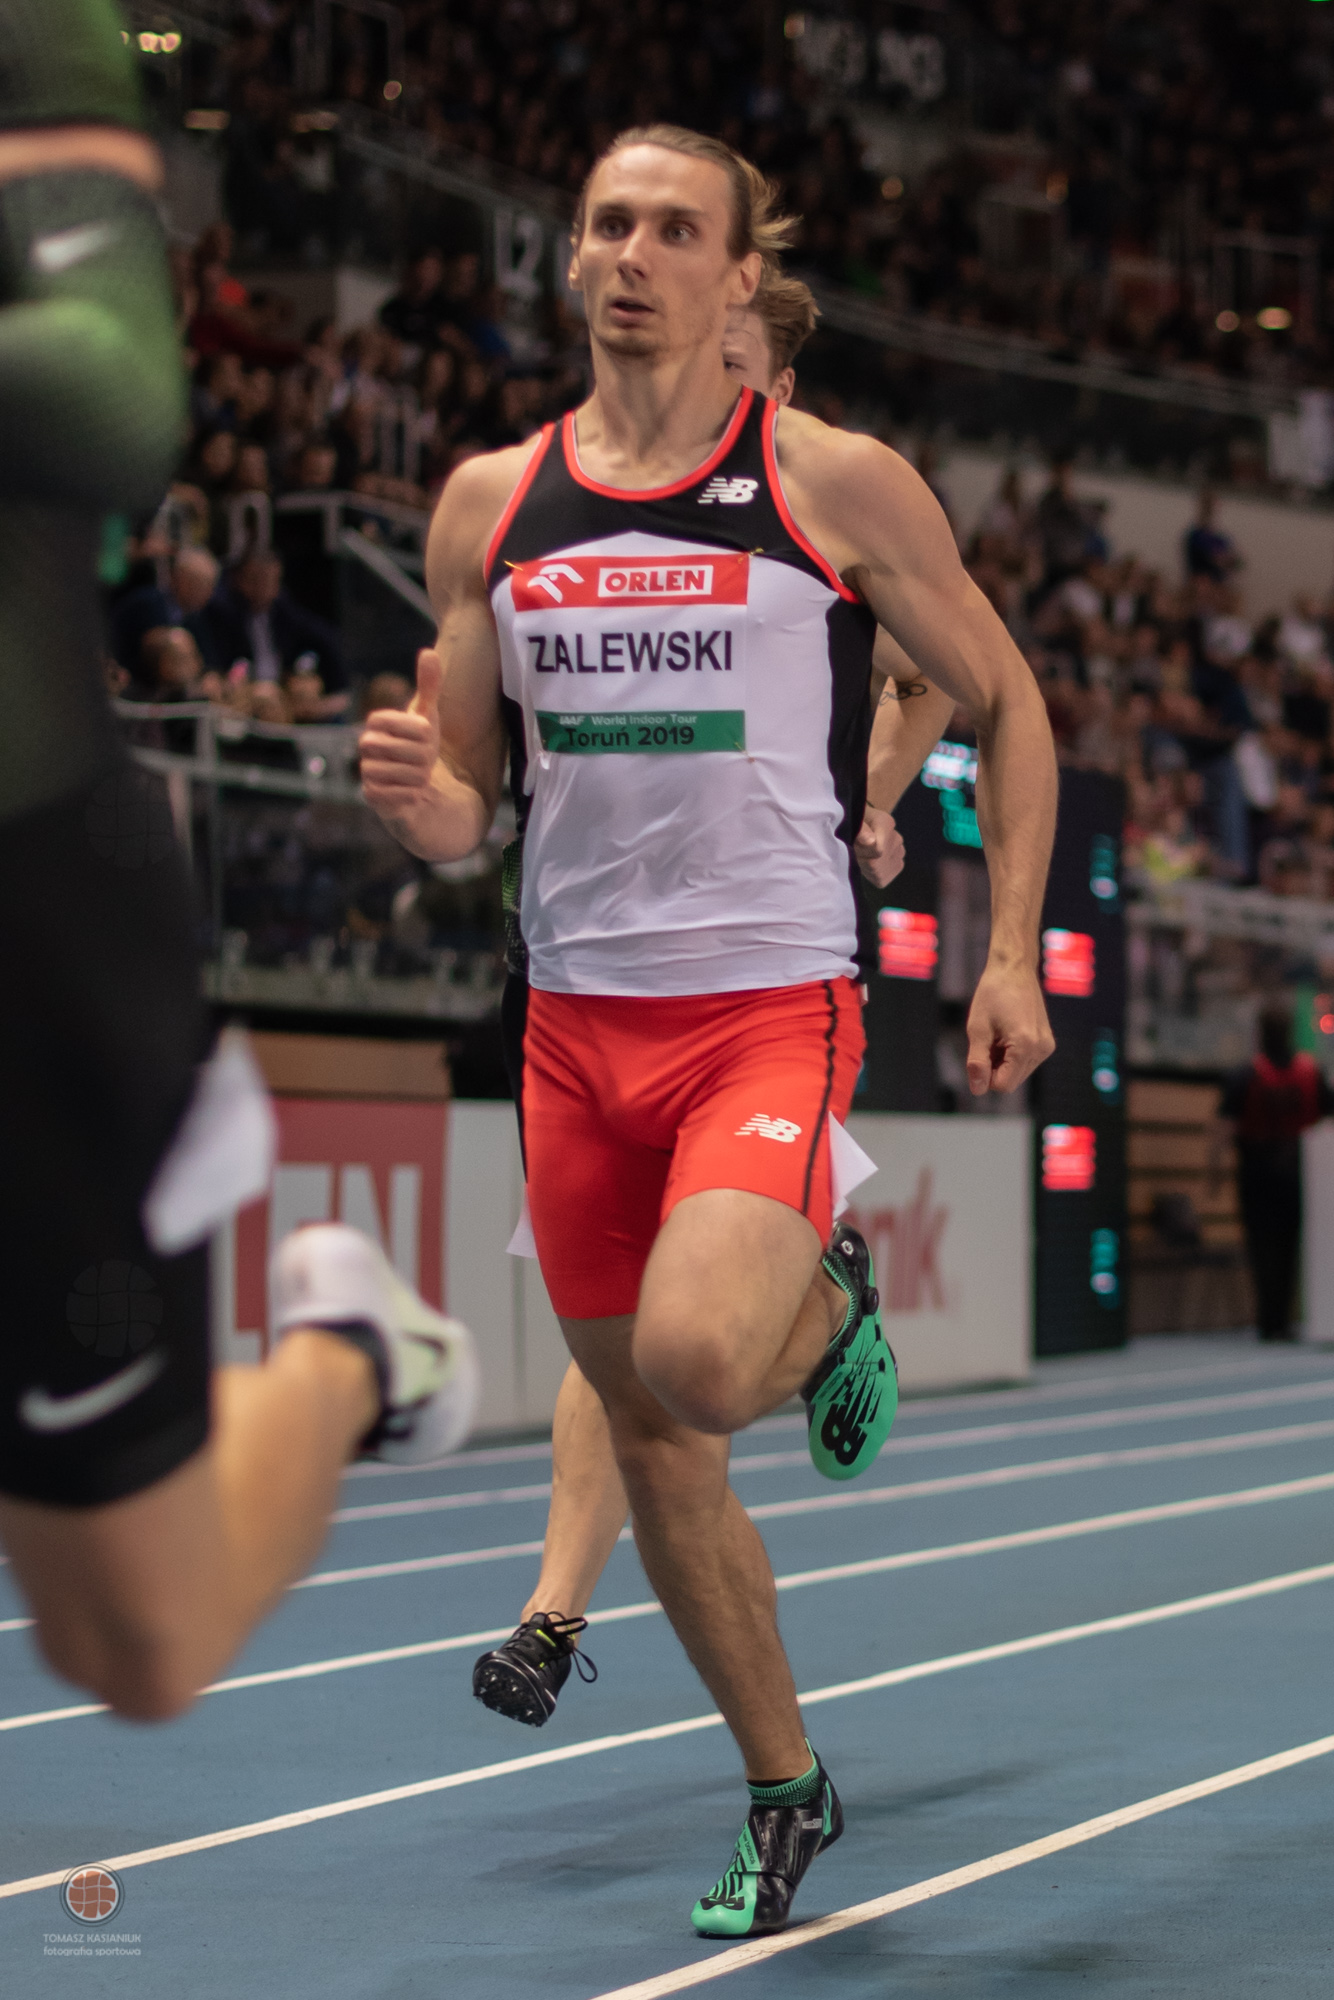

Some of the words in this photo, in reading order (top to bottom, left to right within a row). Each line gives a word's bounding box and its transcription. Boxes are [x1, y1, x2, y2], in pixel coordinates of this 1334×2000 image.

[697, 477, 759, 504] NB
[604, 570, 706, 593] ORLEN
[527, 630, 733, 674] ZALEWSKI
[591, 715, 627, 725] World
[630, 714, 667, 724] Indoor
[670, 713, 698, 724] Tour
[565, 726, 629, 747] Toruń
[637, 726, 695, 745] 2019
